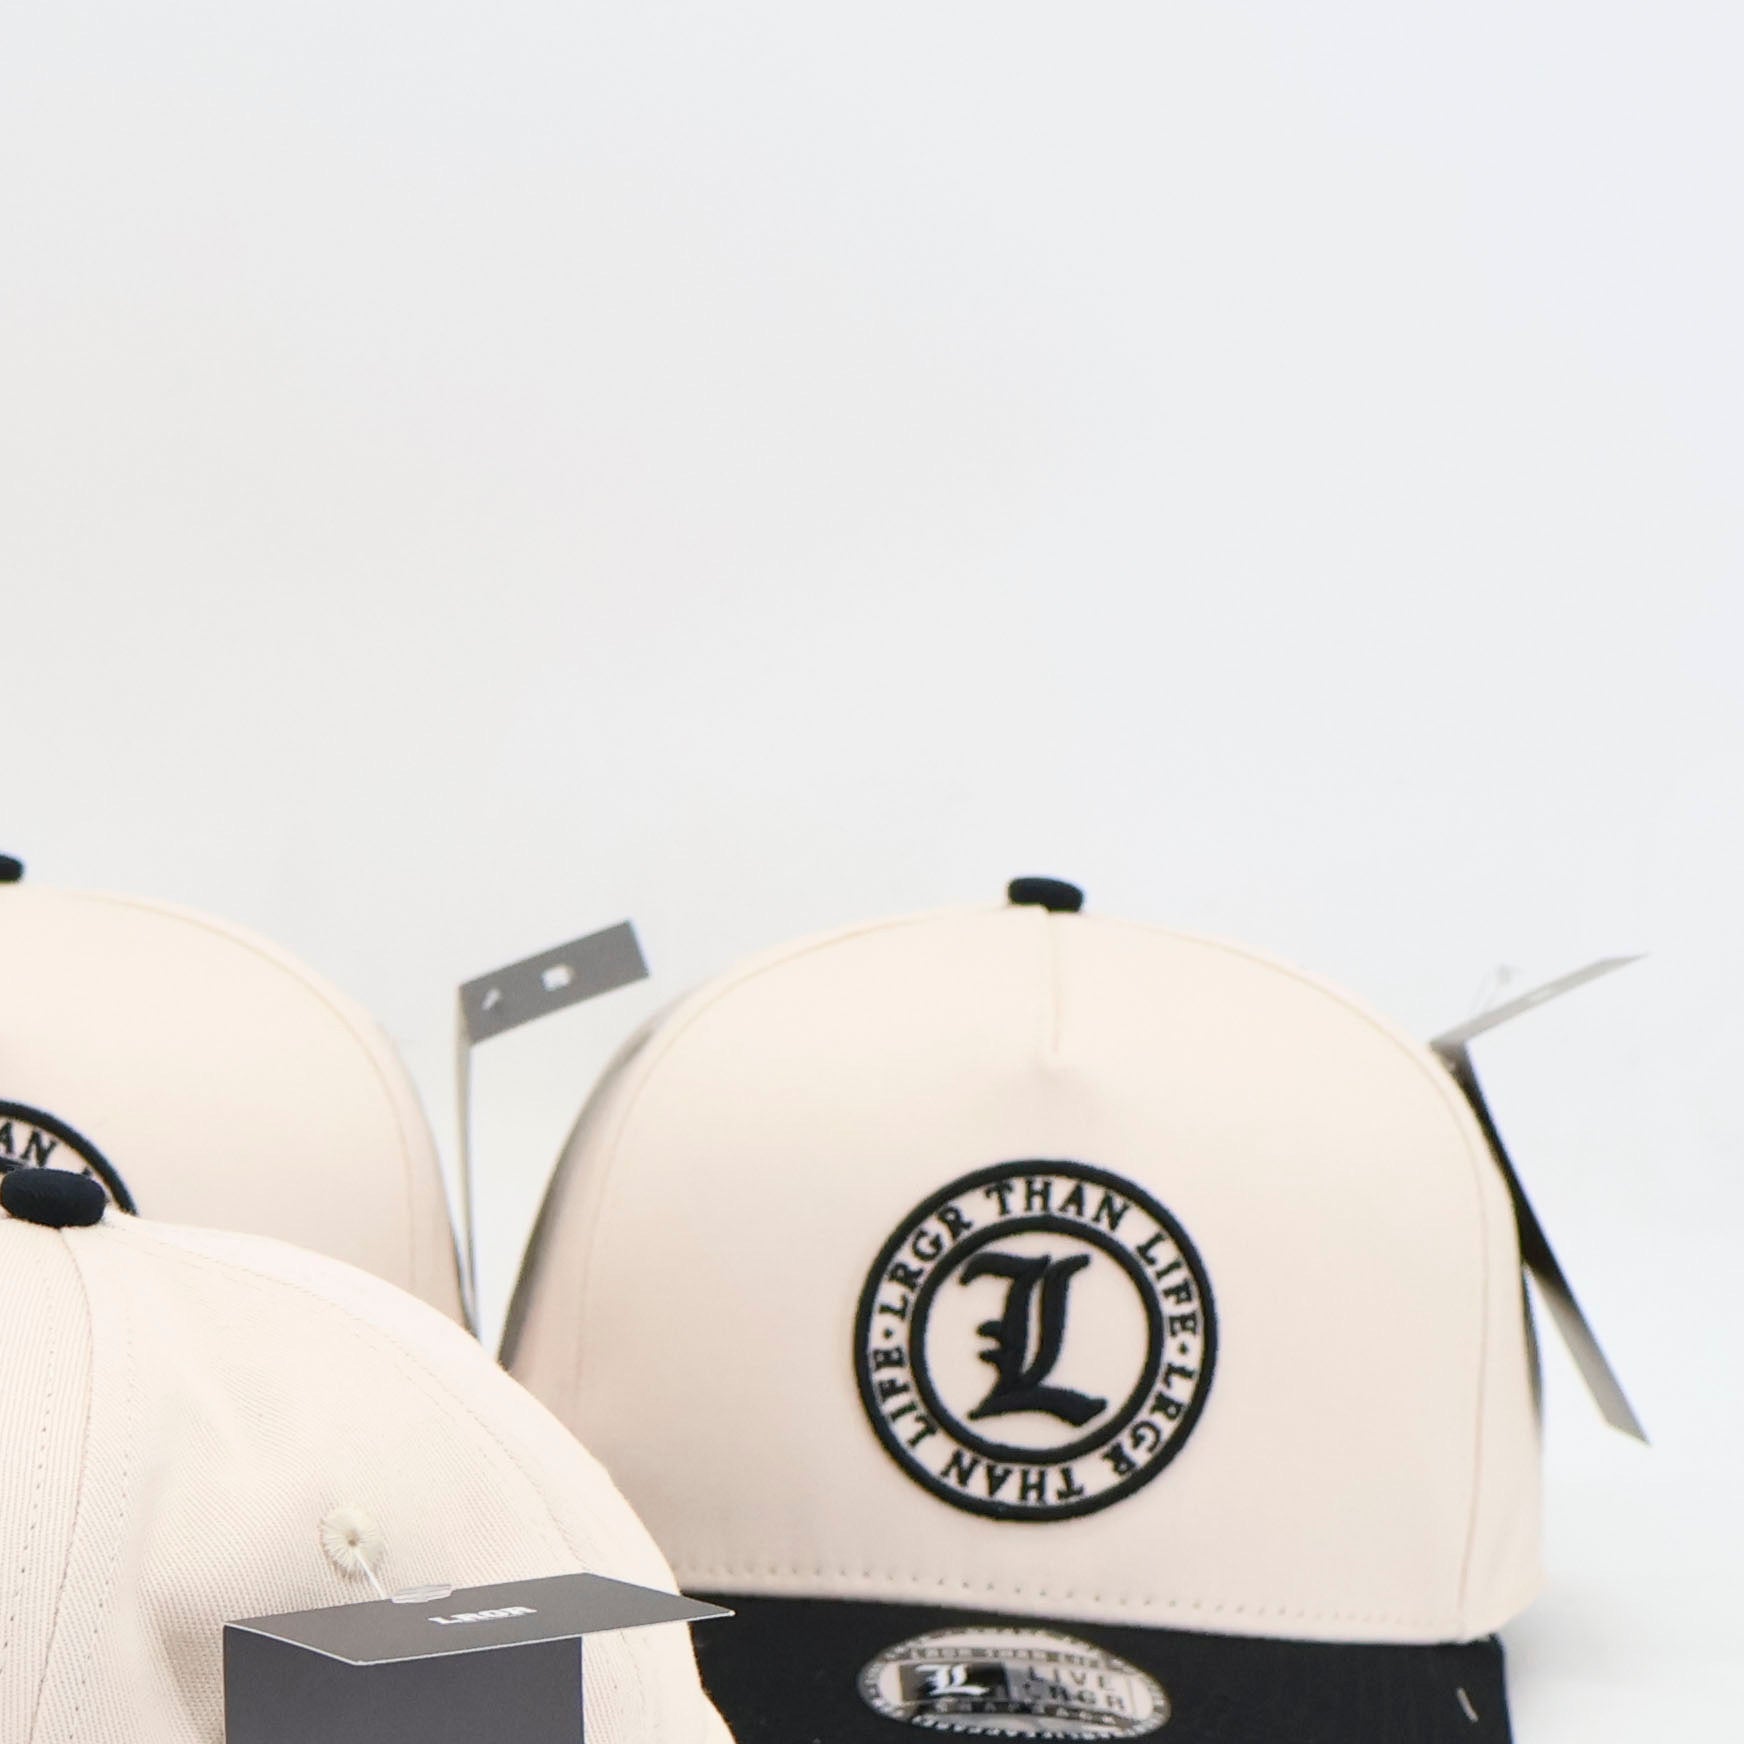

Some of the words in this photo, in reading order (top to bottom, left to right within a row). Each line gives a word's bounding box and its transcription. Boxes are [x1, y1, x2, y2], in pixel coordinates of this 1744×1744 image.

[878, 1205, 973, 1321] LRGR
[984, 1179, 1131, 1232] THAN
[1137, 1232, 1198, 1337] LIFE
[959, 1251, 1108, 1427] L
[873, 1347, 939, 1449] LIFE
[1101, 1362, 1194, 1477] LRGR
[940, 1450, 1084, 1502] THAN
